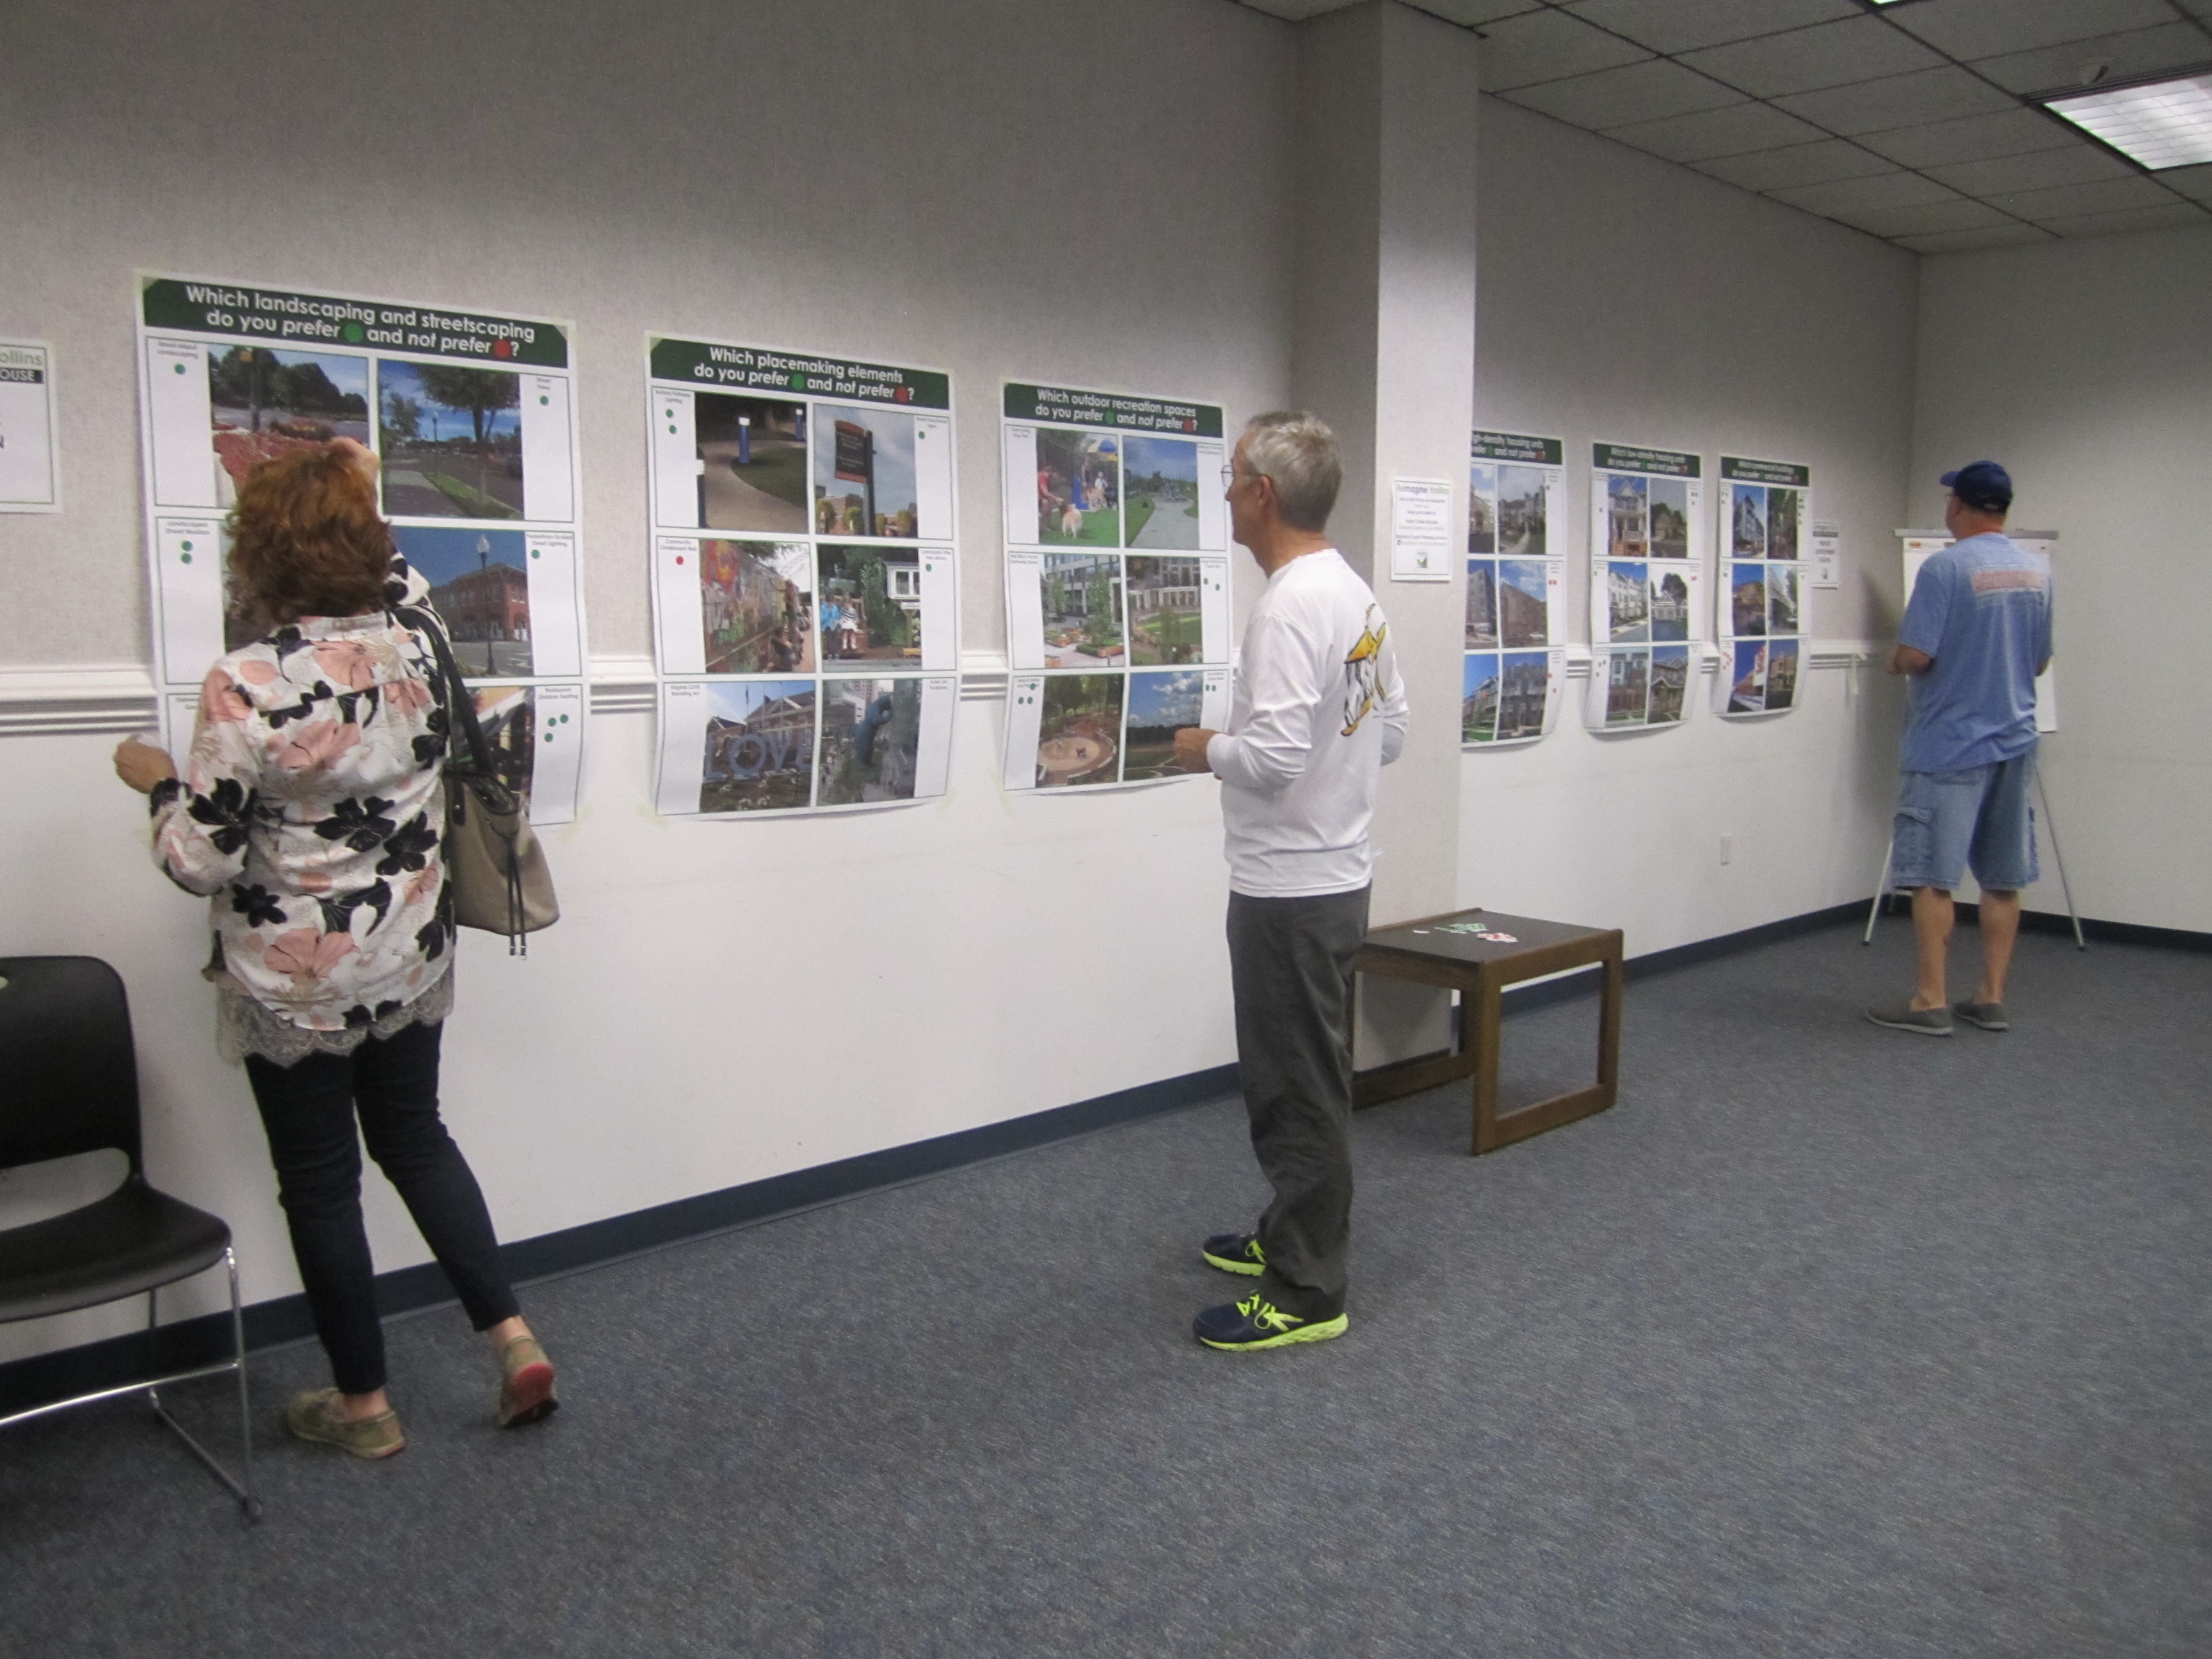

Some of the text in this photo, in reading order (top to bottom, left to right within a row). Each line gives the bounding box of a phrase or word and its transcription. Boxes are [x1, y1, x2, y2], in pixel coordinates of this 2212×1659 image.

[186, 285, 534, 342] Which landscaping and streetscaping
[206, 309, 234, 327] do
[239, 315, 277, 332] you
[282, 320, 341, 337] prefer
[367, 328, 403, 344] and
[408, 333, 437, 348] not
[440, 337, 492, 353] prefer
[694, 363, 714, 378] do
[717, 368, 745, 382] you
[748, 371, 789, 386] prefer
[807, 378, 832, 391] and
[835, 381, 856, 394] not
[858, 385, 895, 397] prefer
[709, 346, 903, 383] Which placemaking elements
[1035, 403, 1049, 416] do
[1052, 407, 1071, 419] you
[1073, 408, 1103, 421] prefer
[1117, 414, 1135, 424] and
[1138, 416, 1154, 426] not
[1155, 417, 1183, 429] prefer
[1038, 389, 1196, 417] Which outdoor recreation spaces
